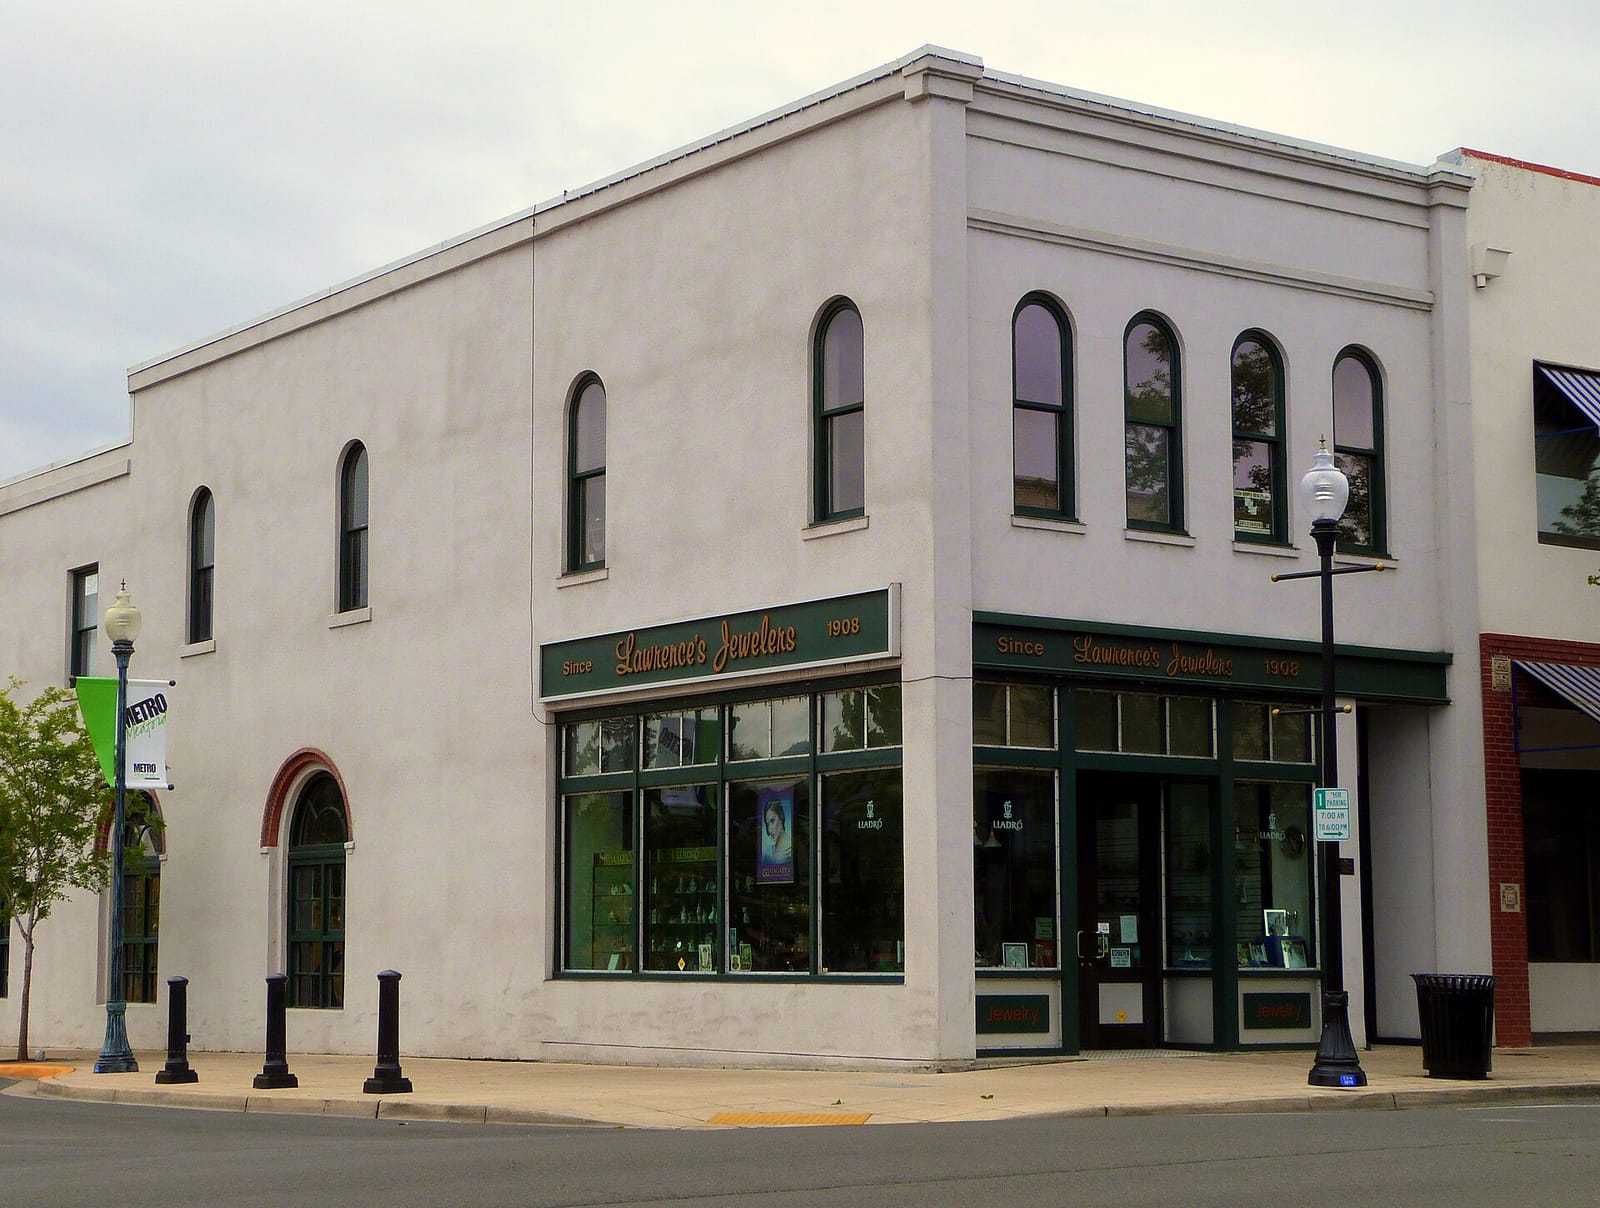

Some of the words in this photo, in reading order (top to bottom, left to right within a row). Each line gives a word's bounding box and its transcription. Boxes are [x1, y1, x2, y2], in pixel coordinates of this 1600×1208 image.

[563, 659, 592, 676] Since
[615, 632, 706, 676] Lawrence's
[713, 615, 796, 672] Jewelers
[827, 617, 860, 637] 1908
[998, 636, 1044, 656] Since
[1073, 634, 1160, 668] Lawrence's
[1166, 642, 1233, 676] Jewelers
[1264, 659, 1298, 676] 1908
[125, 693, 168, 729] METRO
[133, 763, 157, 773] METRO
[983, 1004, 1039, 1025] Jewelry
[1256, 1002, 1302, 1022] Jewelry
